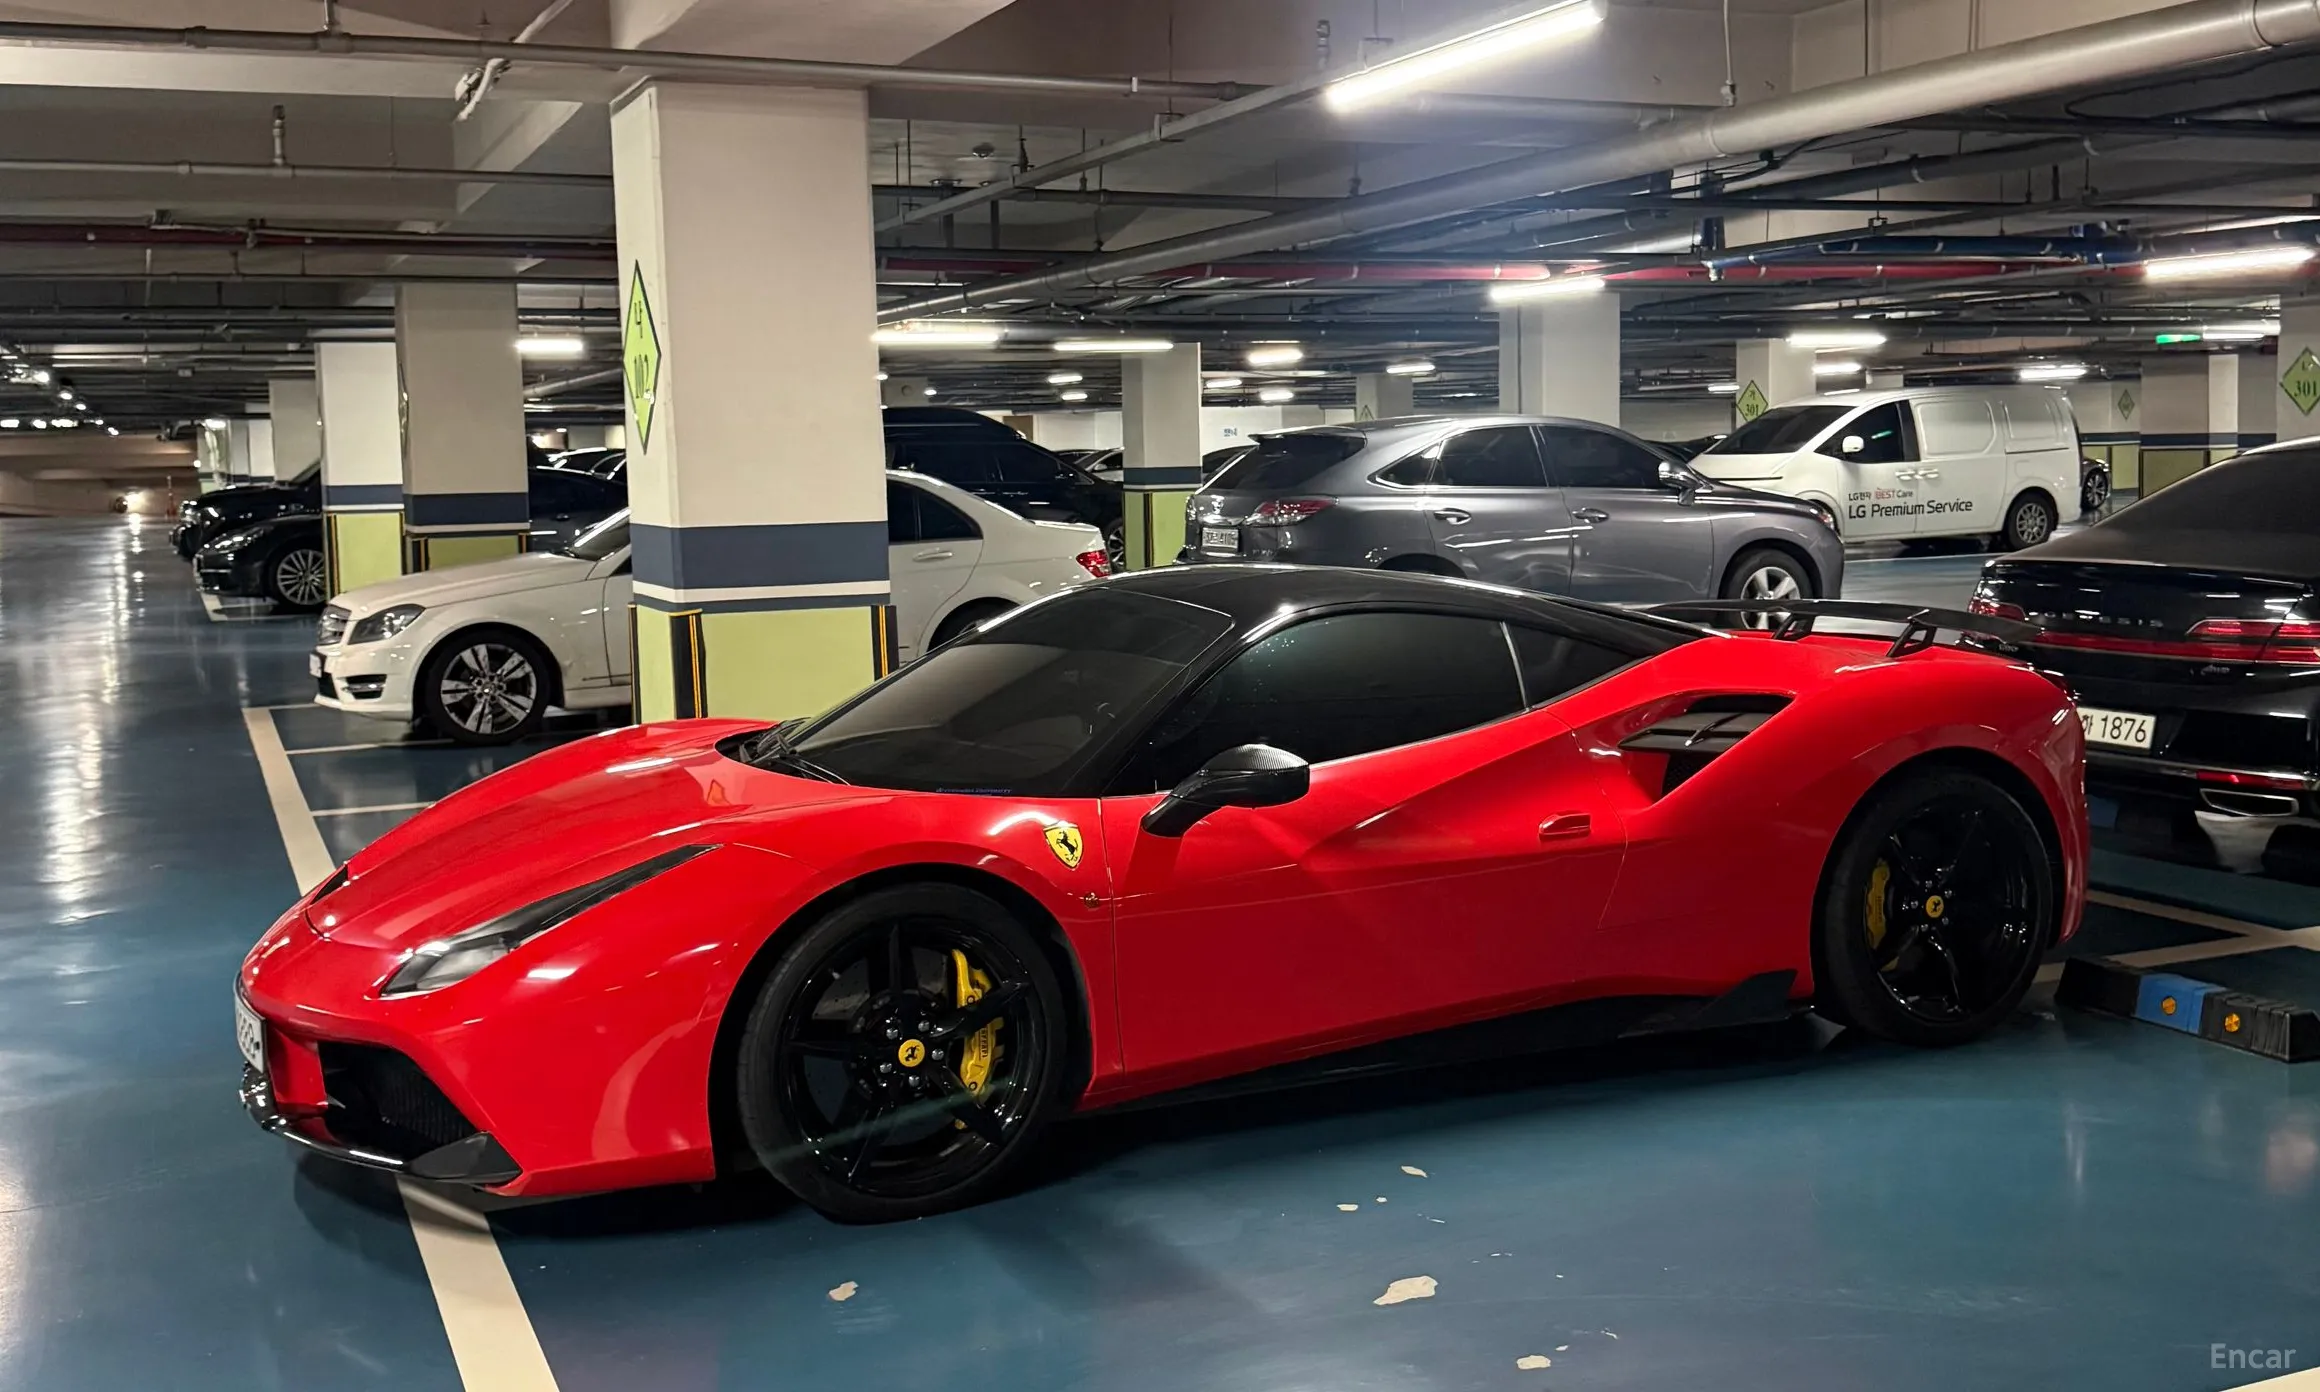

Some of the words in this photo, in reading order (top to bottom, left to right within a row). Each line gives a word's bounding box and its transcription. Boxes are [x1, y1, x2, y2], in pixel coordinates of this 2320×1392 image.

[2294, 380, 2317, 397] 301
[1745, 404, 1759, 416] 301
[1875, 488, 1895, 500] BEST
[1896, 489, 1914, 498] Care
[1848, 504, 1866, 519] LG
[1871, 501, 1925, 518] Premium
[1926, 498, 1973, 514] Service
[2100, 715, 2146, 743] 1876
